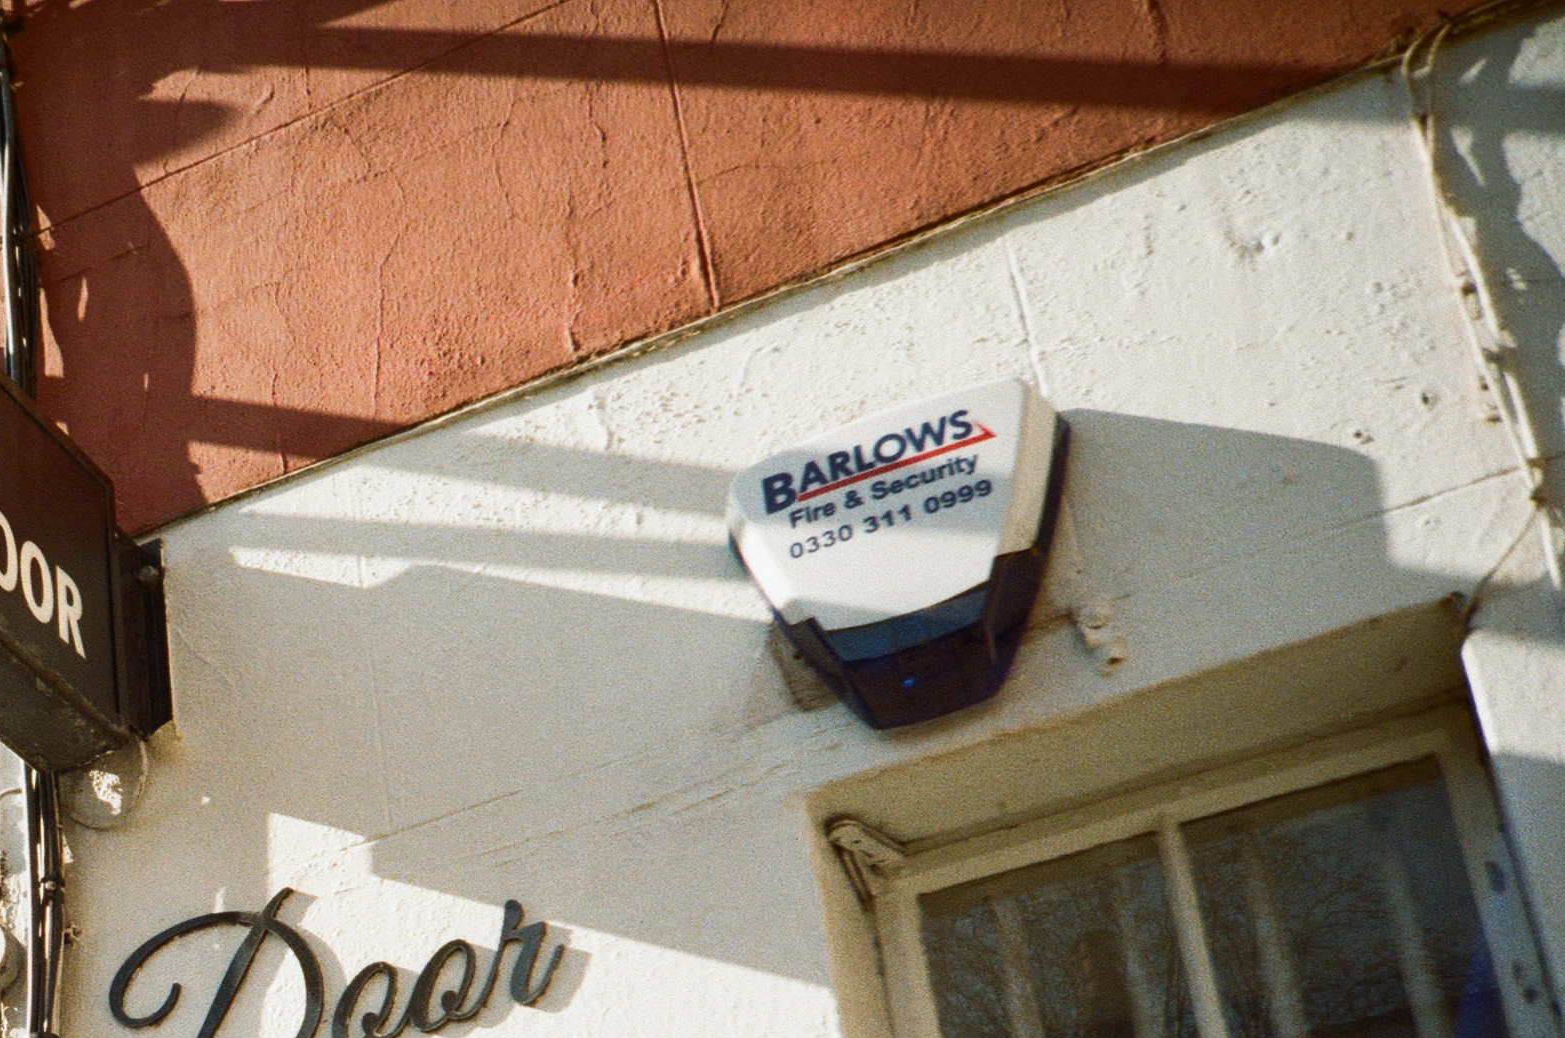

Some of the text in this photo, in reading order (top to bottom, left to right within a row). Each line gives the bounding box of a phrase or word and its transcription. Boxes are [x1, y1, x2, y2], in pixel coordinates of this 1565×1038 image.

[762, 410, 973, 515] BARLOWS
[789, 455, 979, 529] Fire & Security
[789, 479, 993, 559] 0330 311 0999
